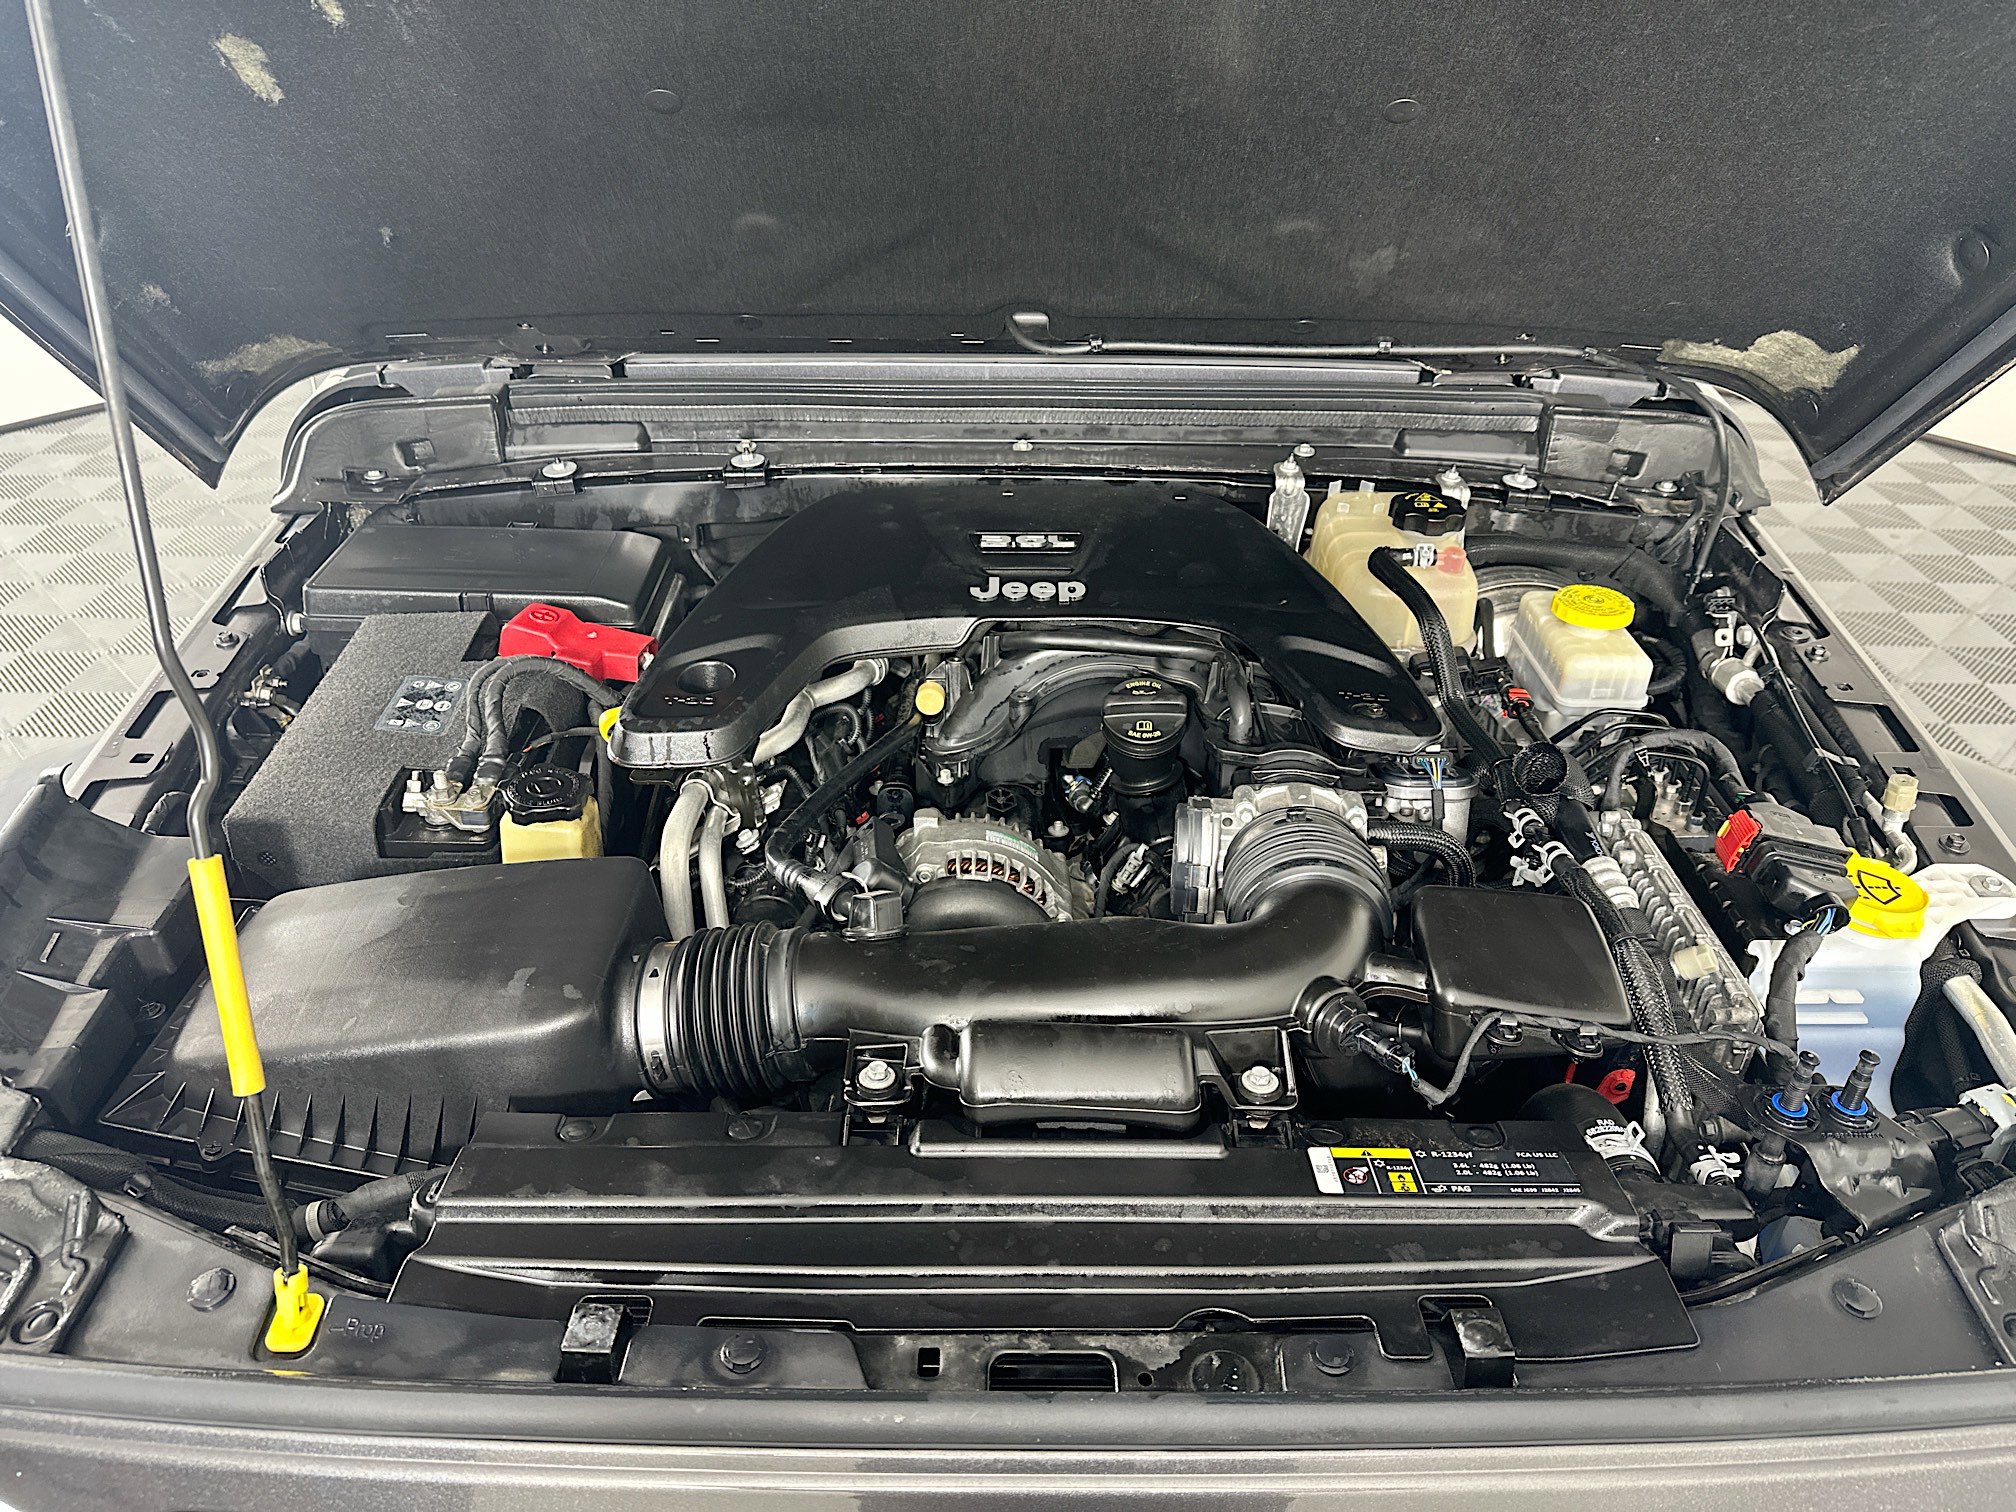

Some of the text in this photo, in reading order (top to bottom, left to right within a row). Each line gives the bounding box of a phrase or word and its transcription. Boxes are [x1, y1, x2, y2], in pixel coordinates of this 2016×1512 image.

[980, 534, 1076, 549] 3.6L
[970, 576, 1086, 605] Jeep
[1125, 681, 1162, 690] ENGINE OIL
[1127, 730, 1141, 738] SAE
[1596, 1118, 1615, 1126] RAD
[1431, 1151, 1473, 1159] R-1234yf
[1451, 1185, 1472, 1193] PAG
[343, 1317, 386, 1343] Prop
